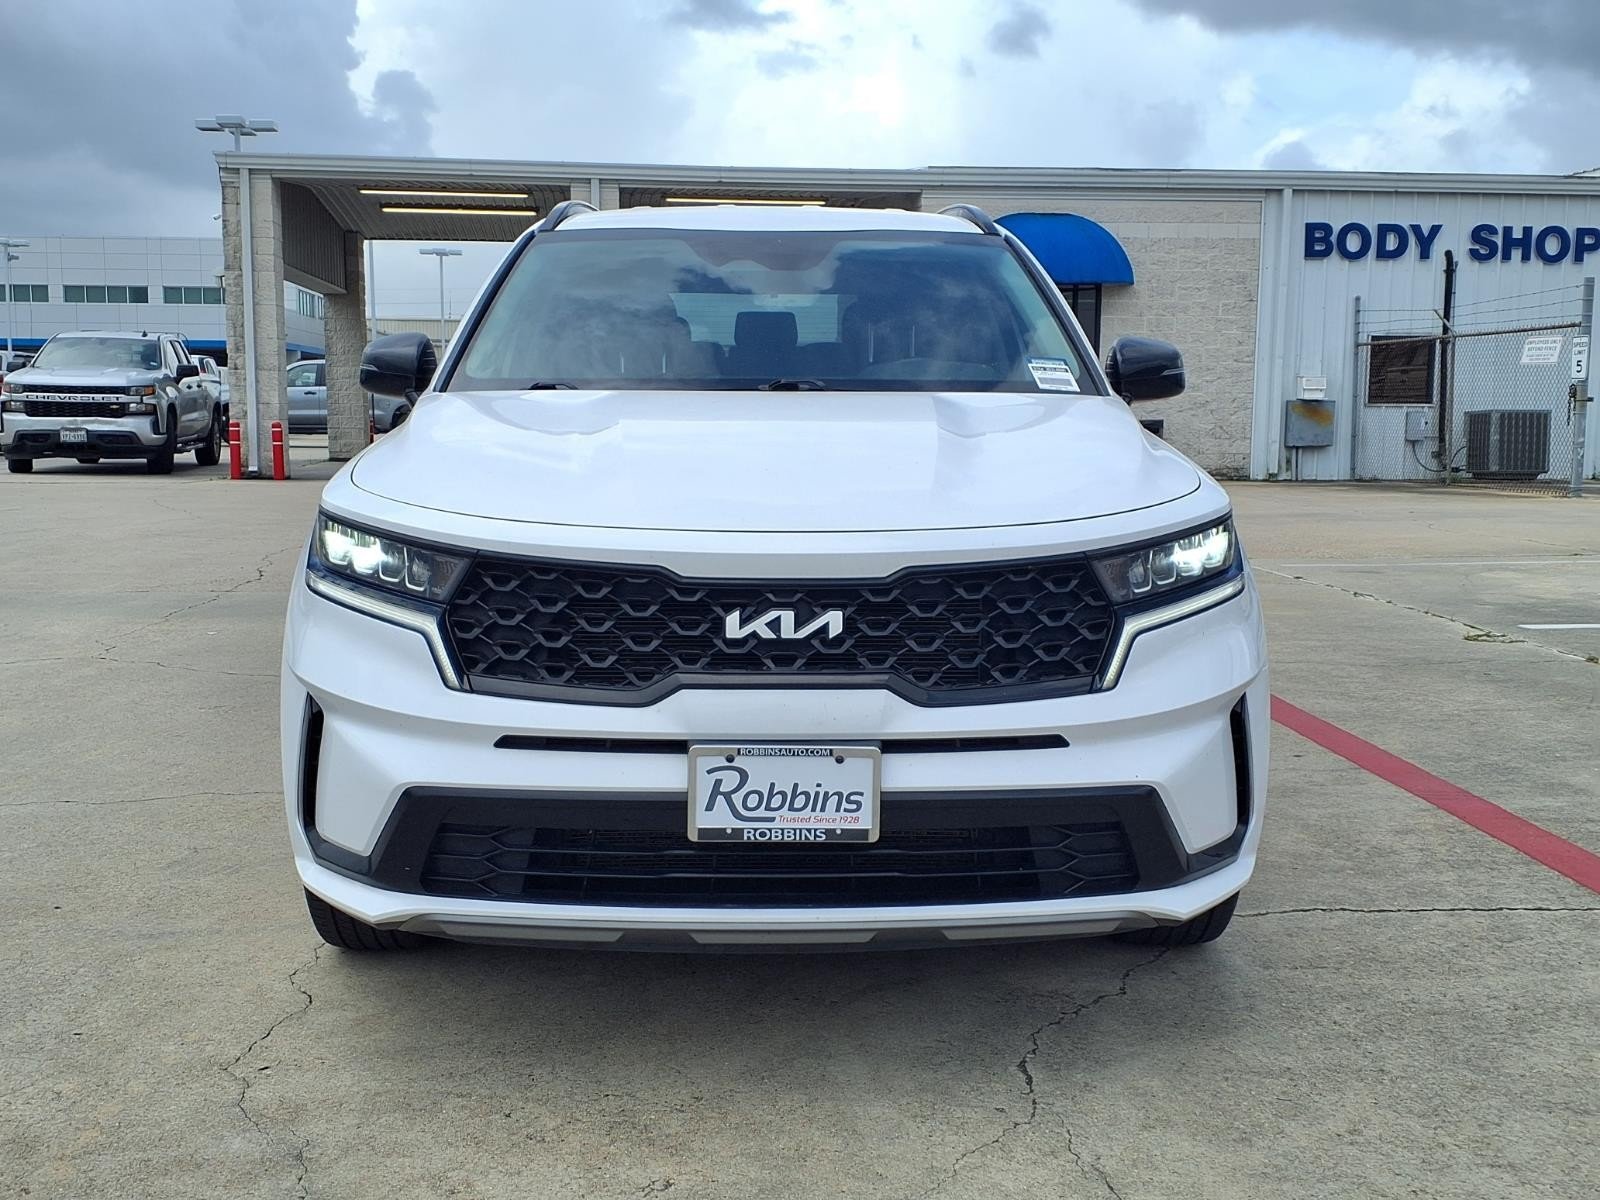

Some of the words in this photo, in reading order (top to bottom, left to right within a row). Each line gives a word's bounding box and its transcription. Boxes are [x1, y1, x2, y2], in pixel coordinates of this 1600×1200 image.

[1304, 222, 1443, 261] BODY
[1468, 223, 1600, 264] SHOP
[1576, 360, 1583, 373] 5
[25, 394, 123, 402] CHEVROLET
[725, 609, 844, 639] KIA
[740, 748, 831, 757] ROBBINSAUTO.COM
[704, 765, 865, 823] Robbins
[778, 815, 811, 824] Trusted
[813, 815, 838, 824] Since
[839, 816, 860, 825] 1928
[743, 828, 827, 841] ROBBINS
